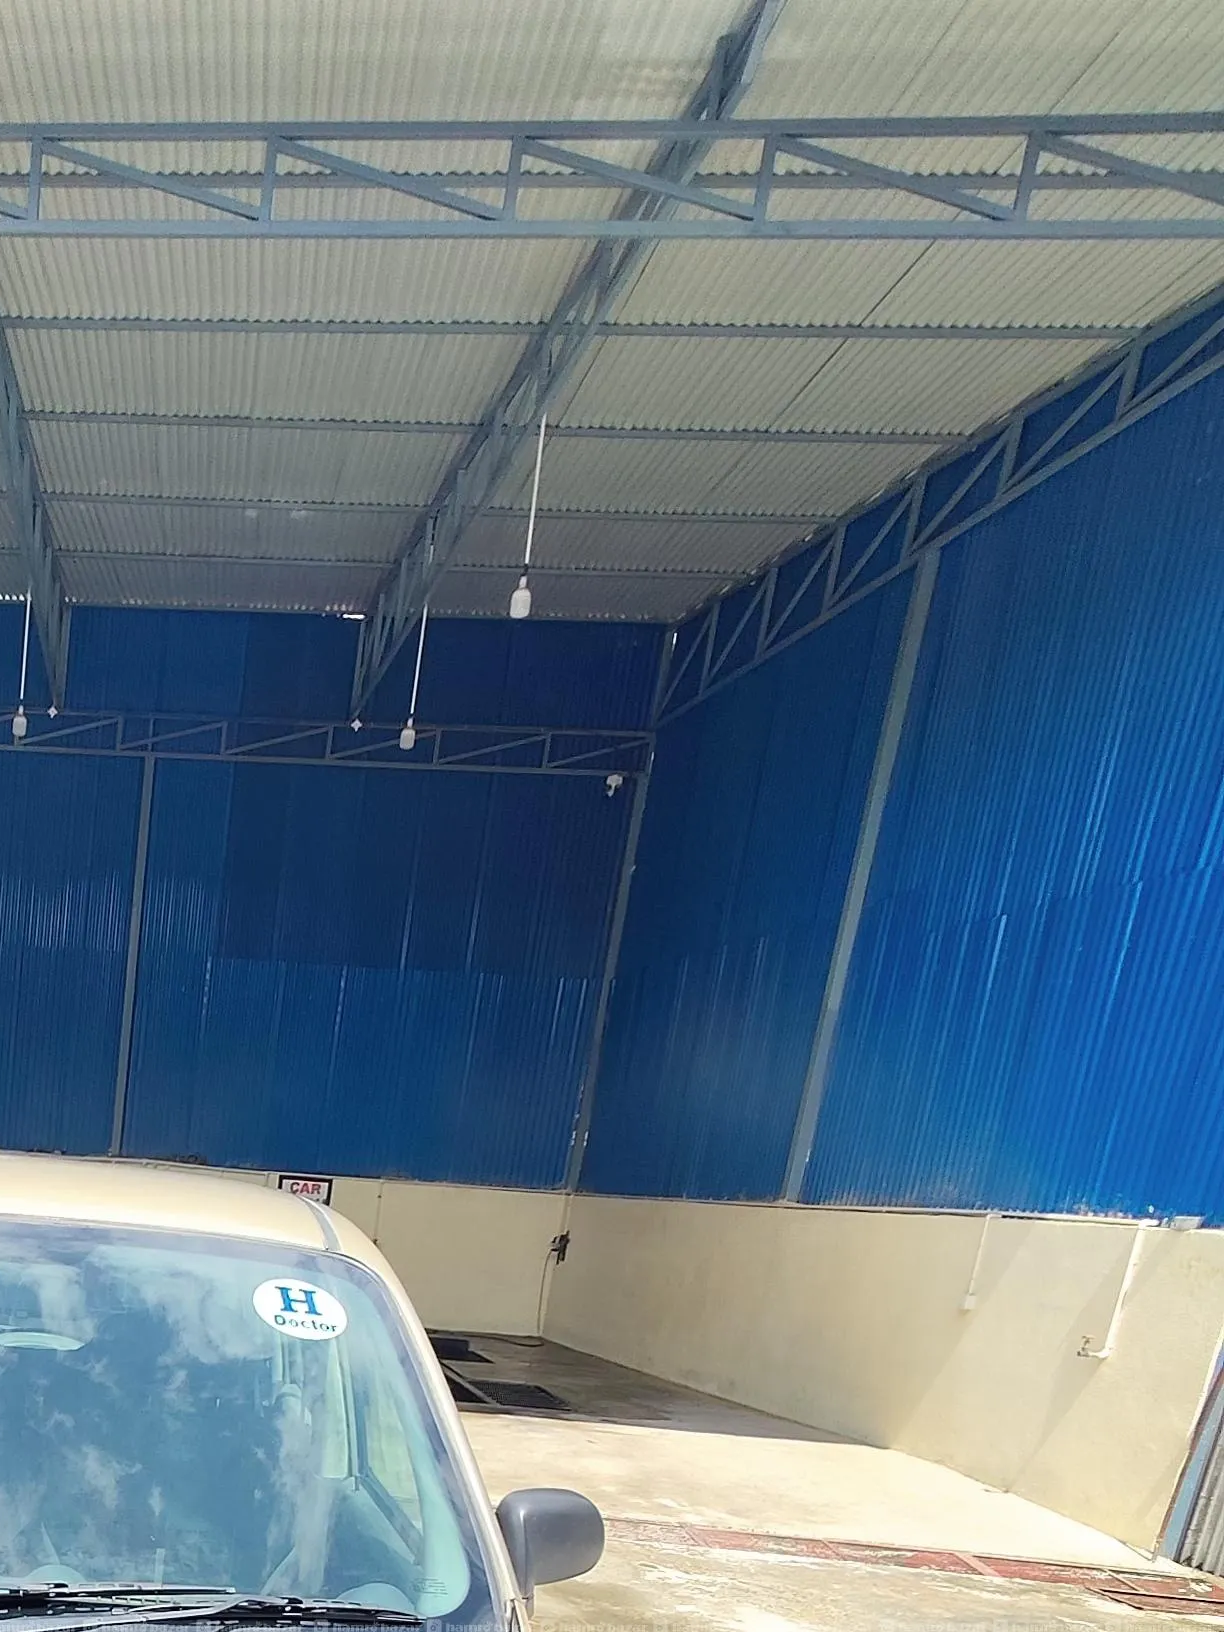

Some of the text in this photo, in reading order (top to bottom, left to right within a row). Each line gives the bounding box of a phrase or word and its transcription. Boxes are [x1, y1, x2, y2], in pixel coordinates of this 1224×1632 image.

[290, 1182, 321, 1194] CAR
[275, 1286, 323, 1316] H
[274, 1314, 337, 1332] Doctor
